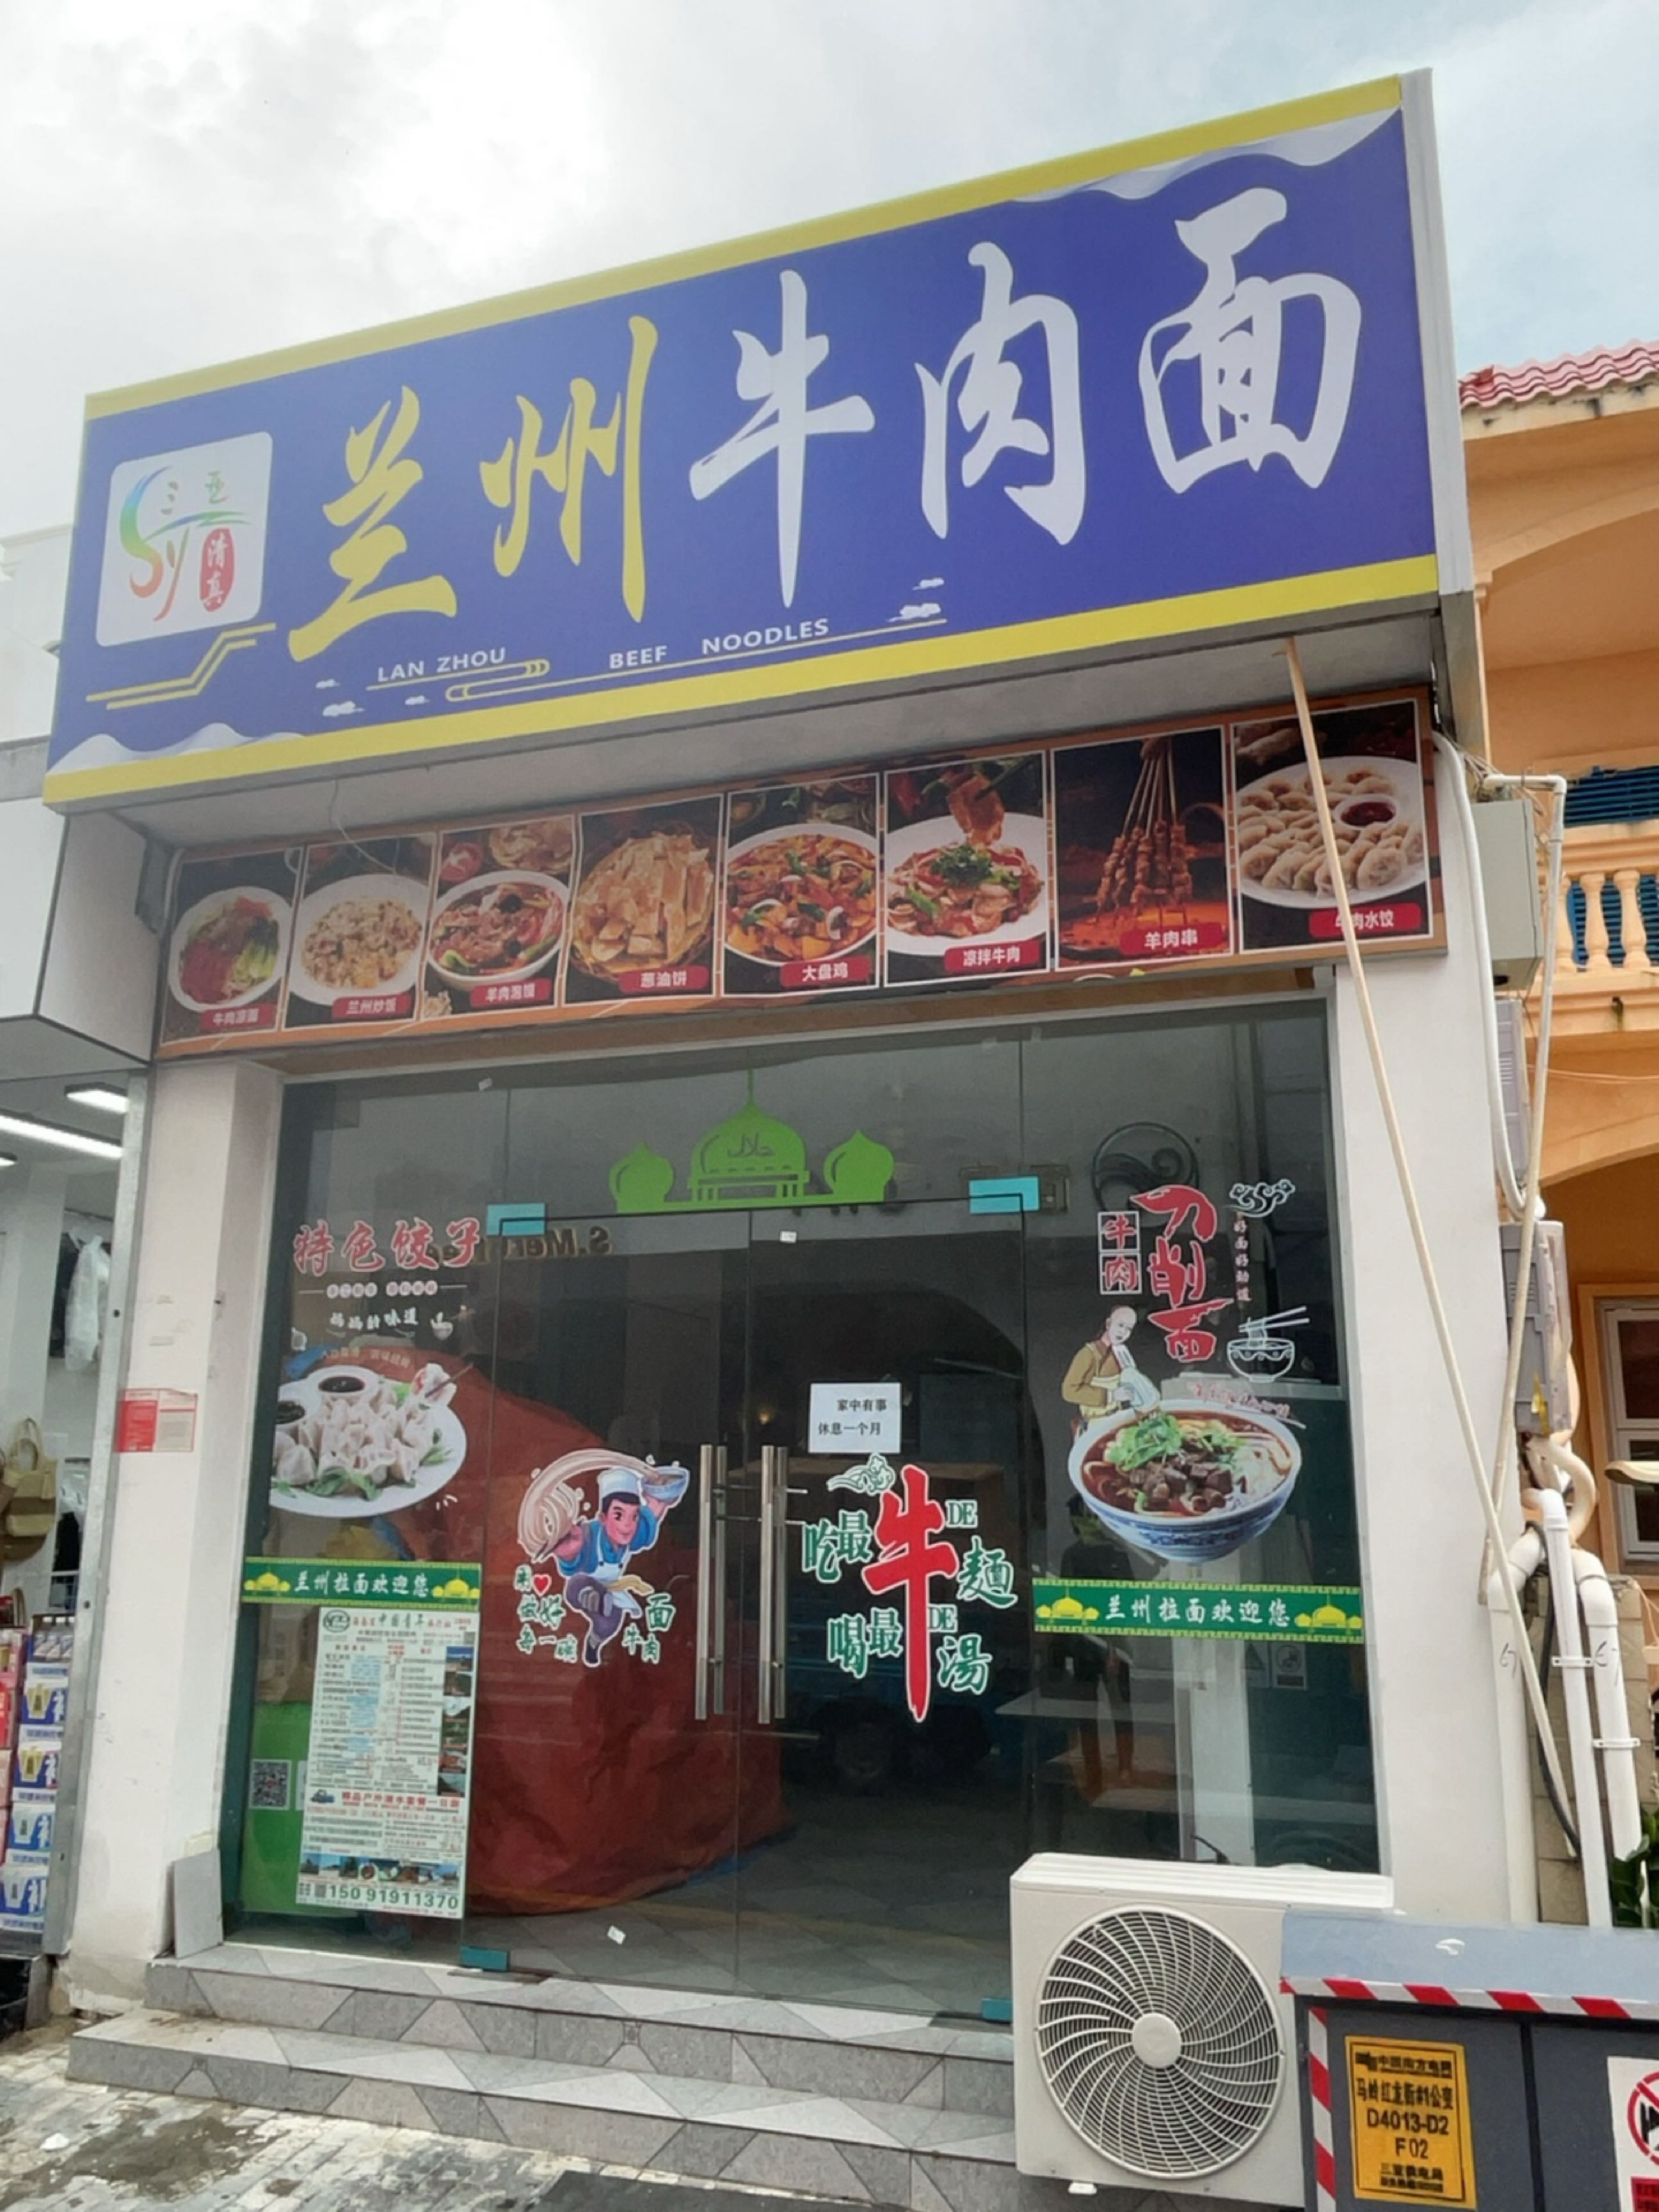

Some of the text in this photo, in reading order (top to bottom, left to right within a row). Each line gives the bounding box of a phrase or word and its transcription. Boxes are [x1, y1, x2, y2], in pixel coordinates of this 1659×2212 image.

[289, 187, 1362, 662] 兰州牛肉面
[377, 618, 830, 682] LAN ZHOU BEEF NOODLES
[1144, 929, 1198, 950] 羊肉串
[962, 945, 1020, 969] 凉拌牛肉
[639, 971, 688, 988] 葱油饼
[801, 963, 849, 982] 大盘鸡
[293, 1216, 481, 1277] 特色饺子
[1102, 1214, 1137, 1291] 牛肉
[1129, 1184, 1234, 1363] 刀削面
[837, 1398, 888, 1413] 家中有事
[818, 1422, 882, 1436] 休息一个月
[944, 1500, 978, 1528] DE
[294, 1569, 430, 1598] 兰州拉面欢迎您
[1105, 1593, 1292, 1628] 兰州拉面欢迎您
[328, 1884, 360, 1900] 150
[367, 1887, 458, 1909] 91911370
[1366, 2108, 1449, 2135] D4013-D2
